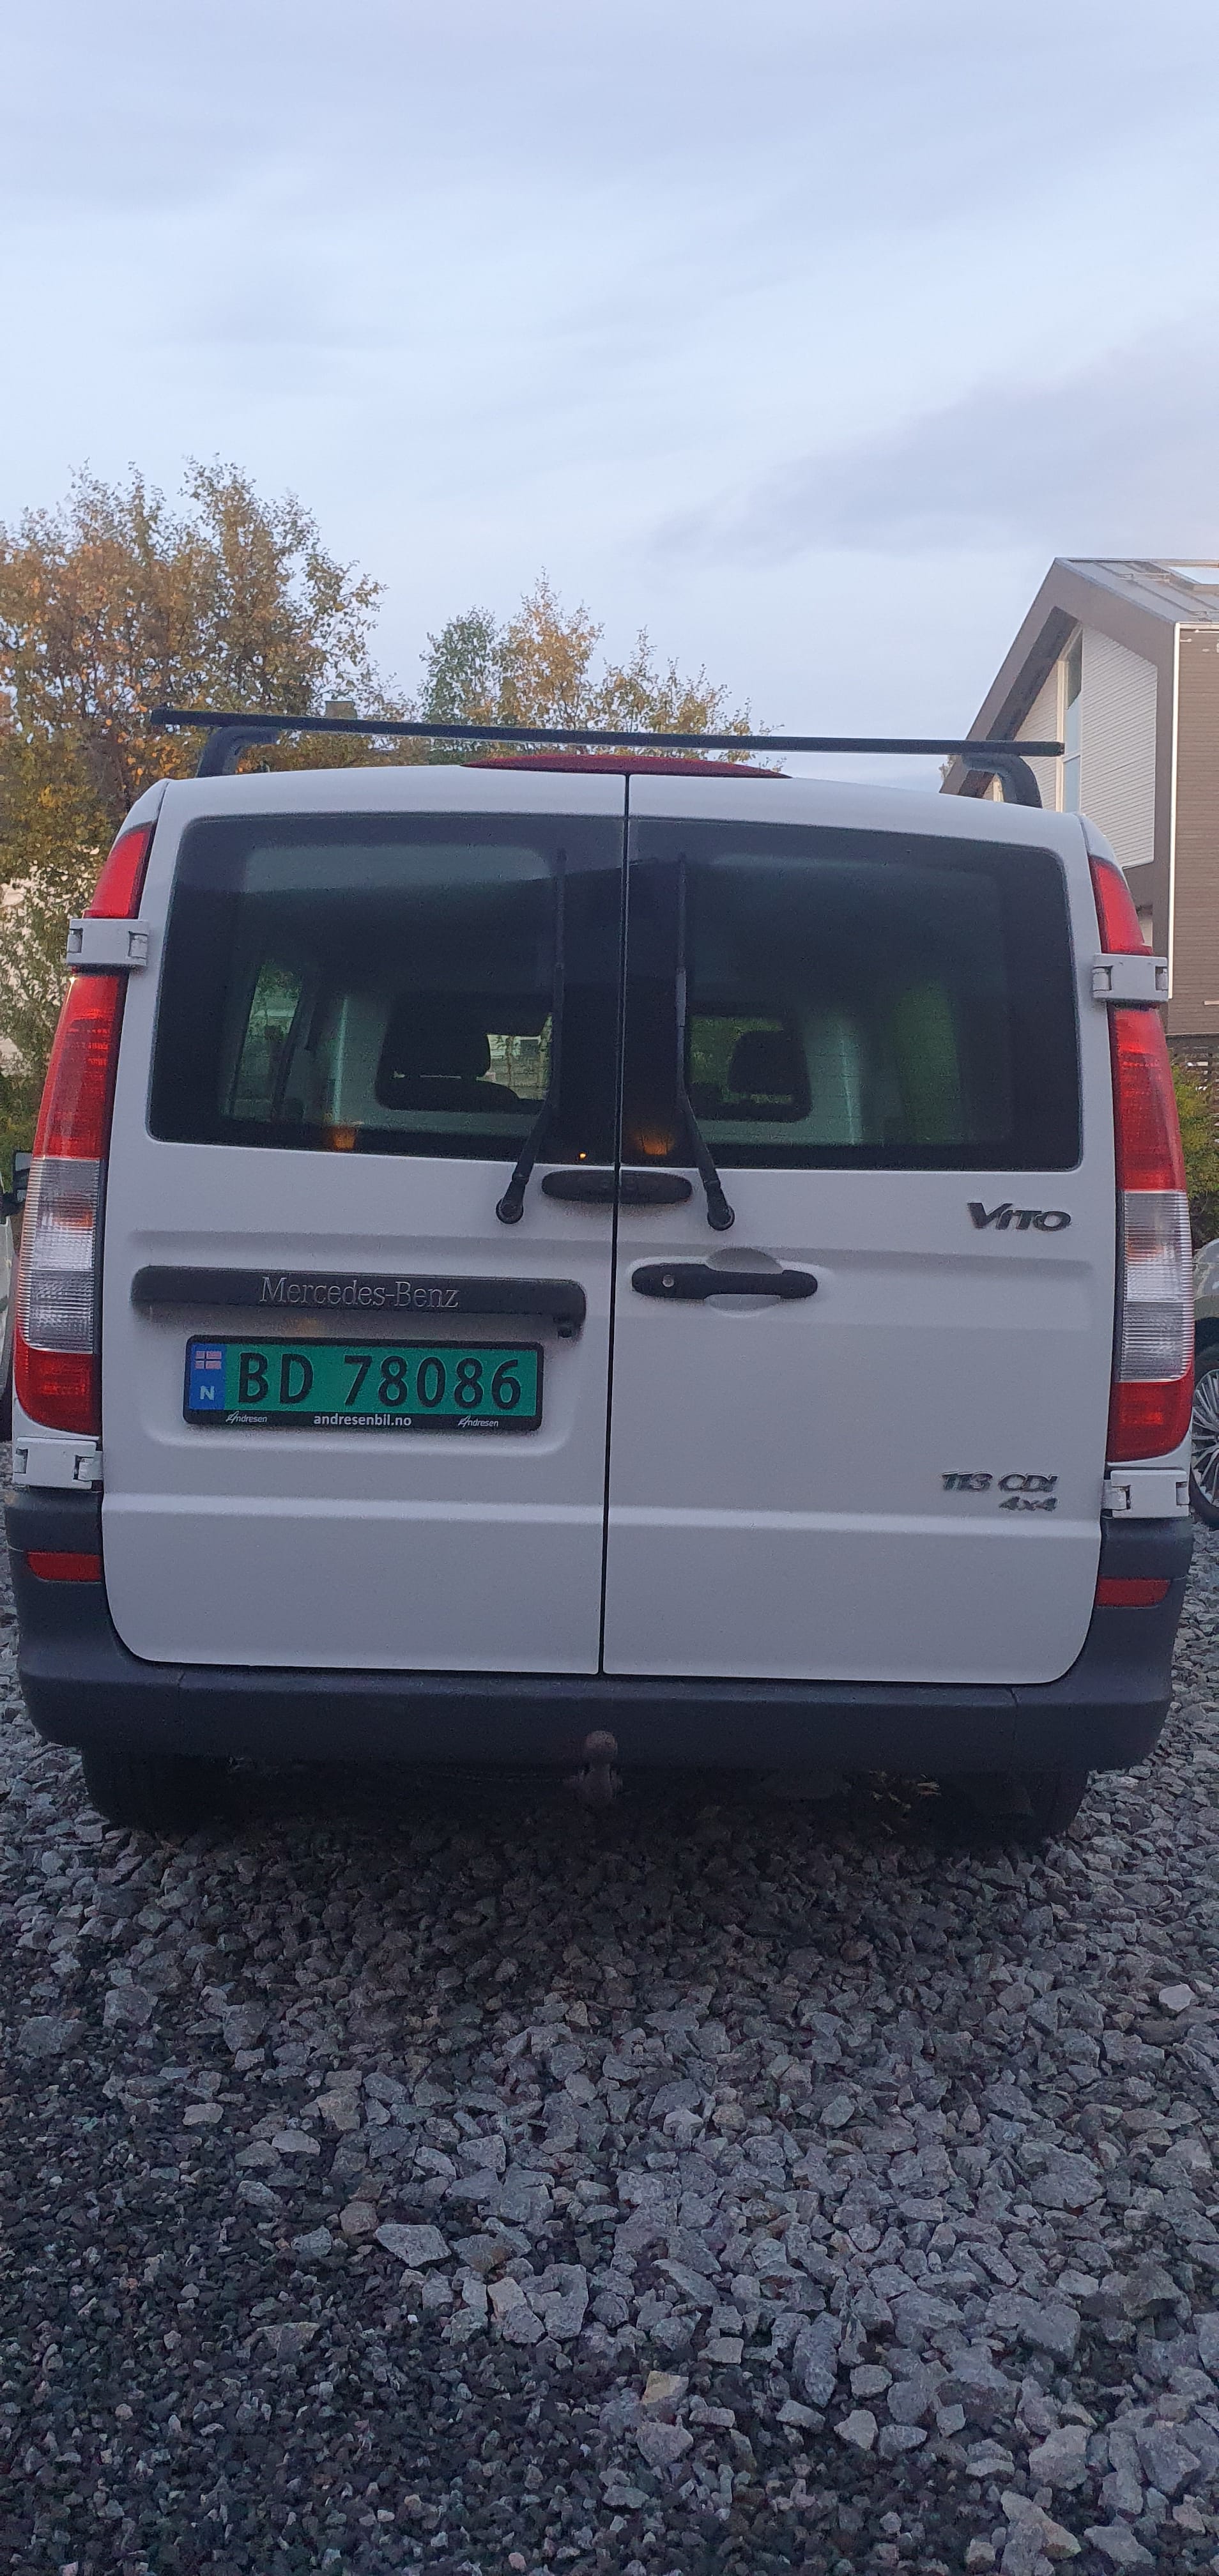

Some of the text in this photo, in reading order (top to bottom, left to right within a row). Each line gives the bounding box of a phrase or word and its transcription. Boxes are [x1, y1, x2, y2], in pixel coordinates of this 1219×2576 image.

[259, 1276, 460, 1308] Mercedes-Benz
[238, 1351, 521, 1411] BD 78086
[199, 1385, 215, 1400] N
[314, 1413, 412, 1426] andresenbil.no
[942, 1471, 1058, 1492] 113 CDI
